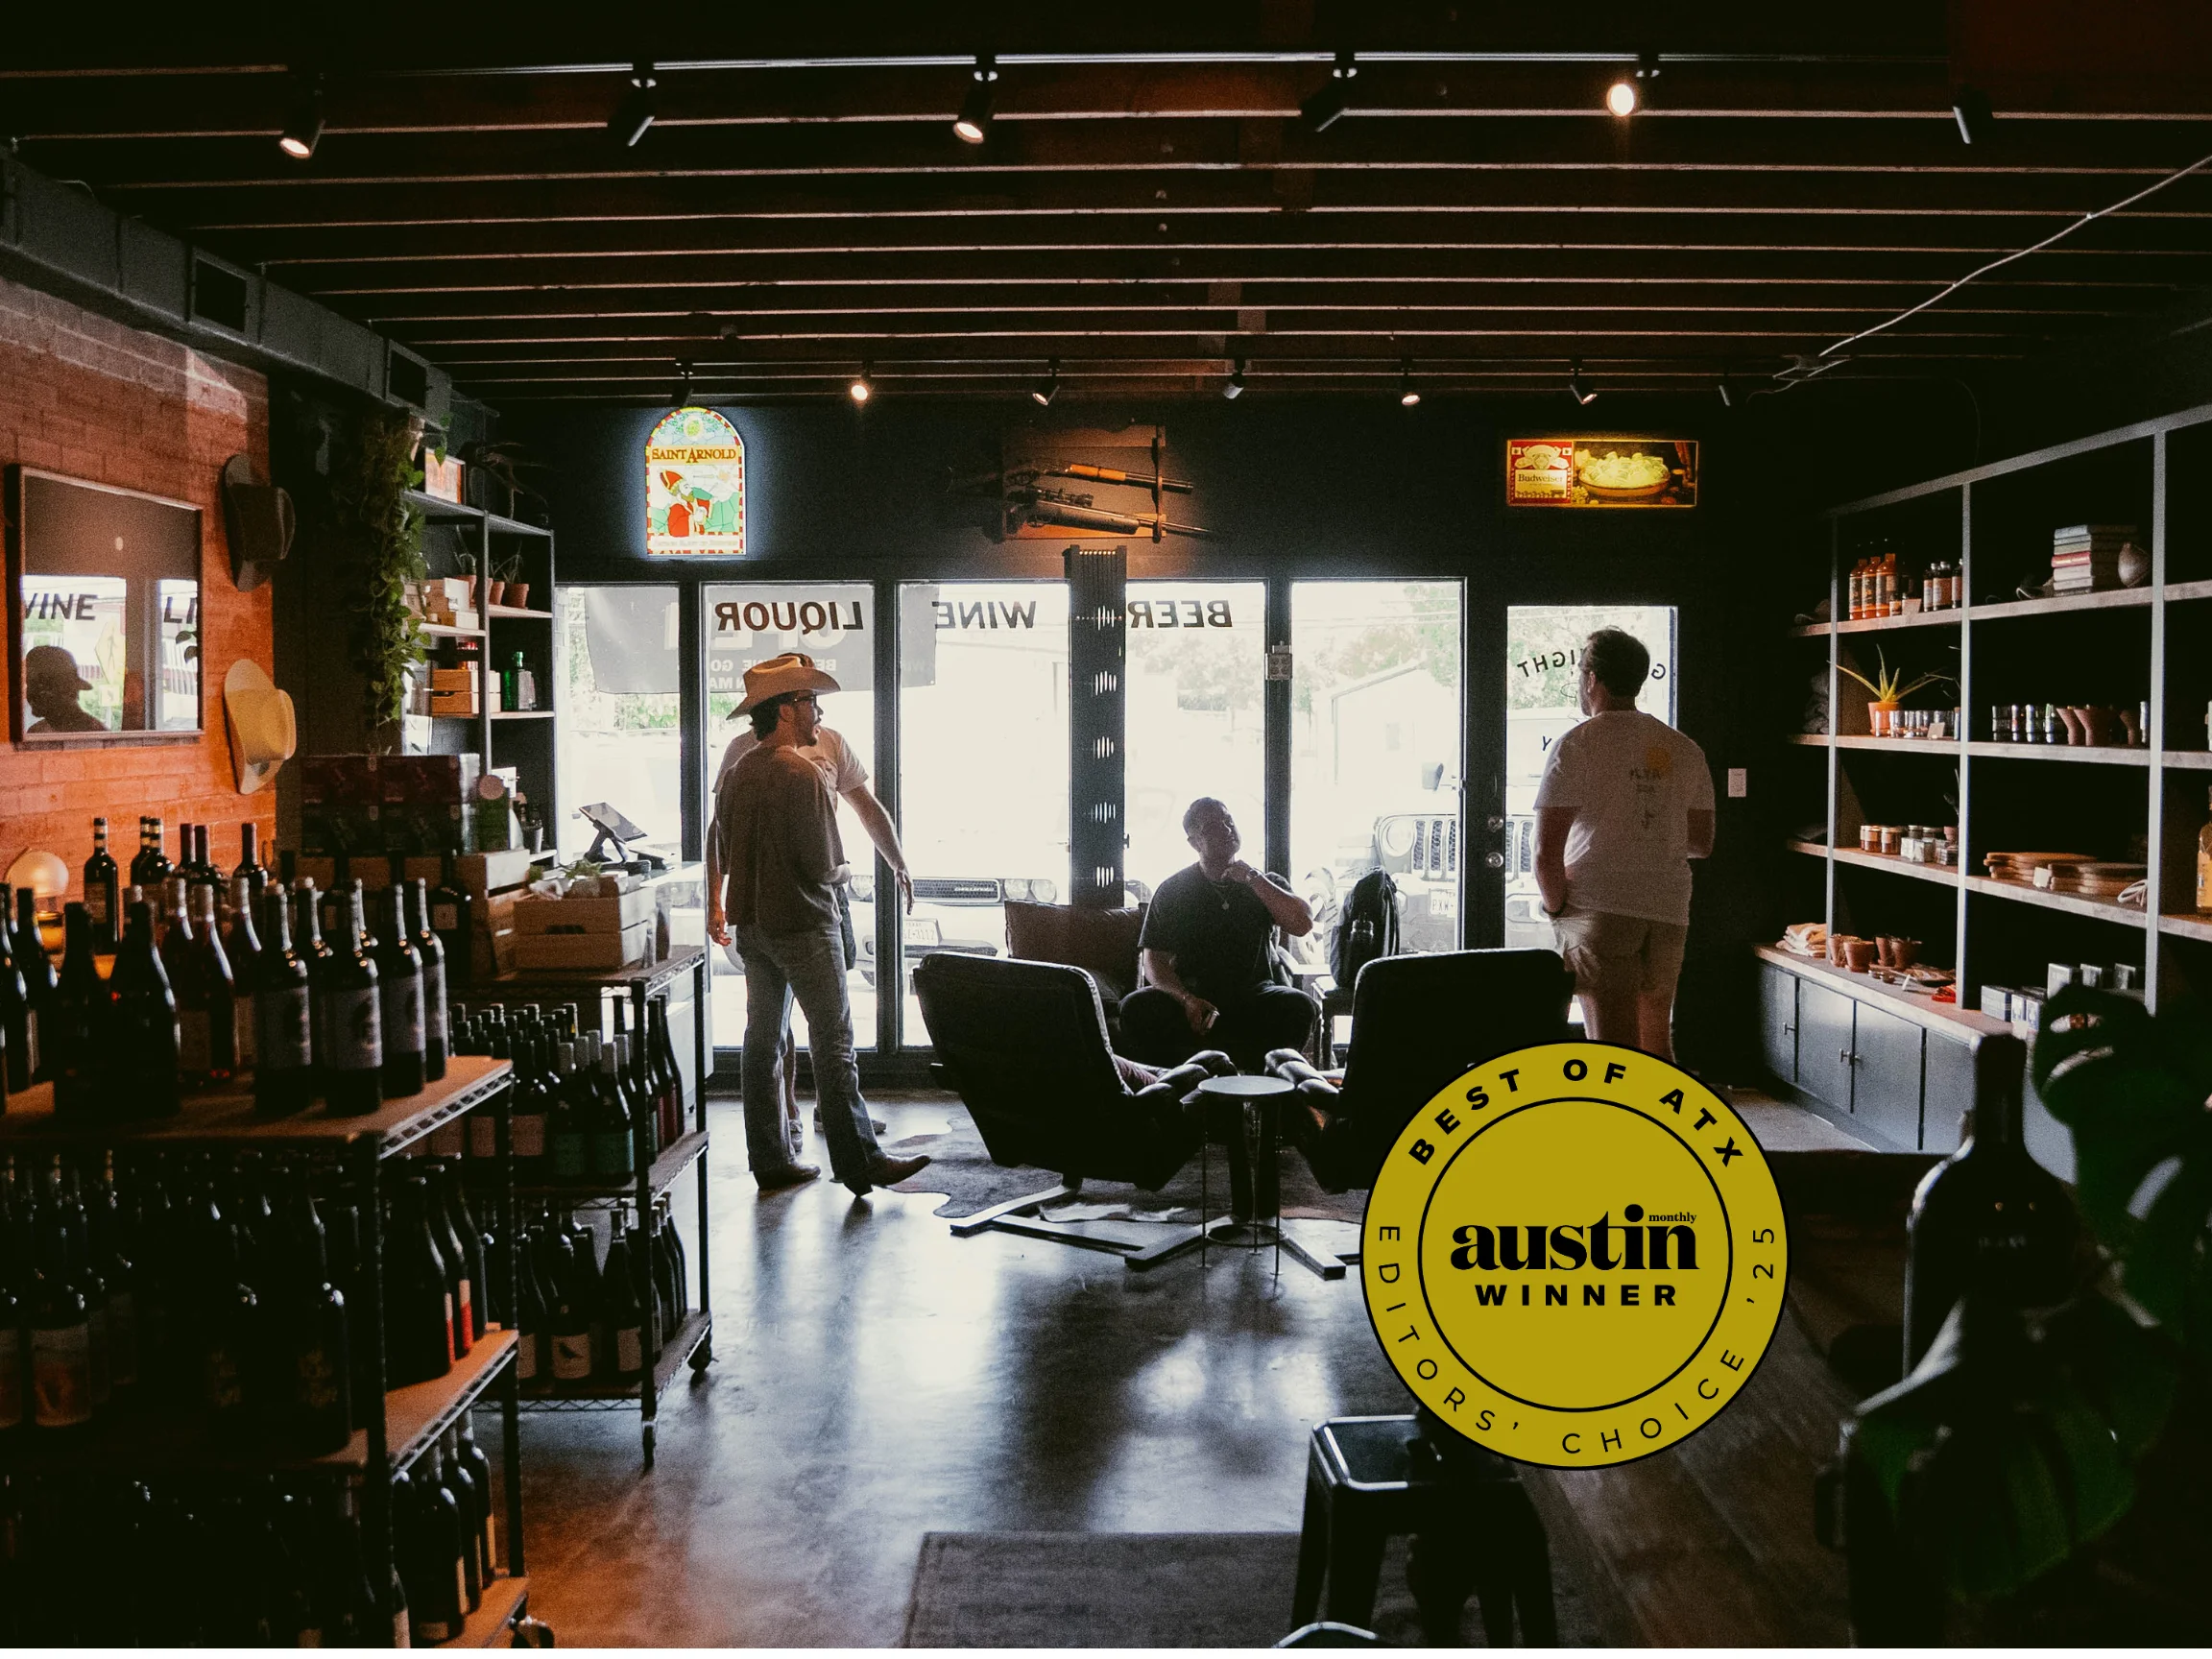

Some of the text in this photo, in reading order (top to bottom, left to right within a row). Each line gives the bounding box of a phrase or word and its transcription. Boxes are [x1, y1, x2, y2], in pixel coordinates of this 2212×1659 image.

[651, 447, 736, 463] SAINT ARNOLD
[1517, 473, 1564, 483] Budweiser
